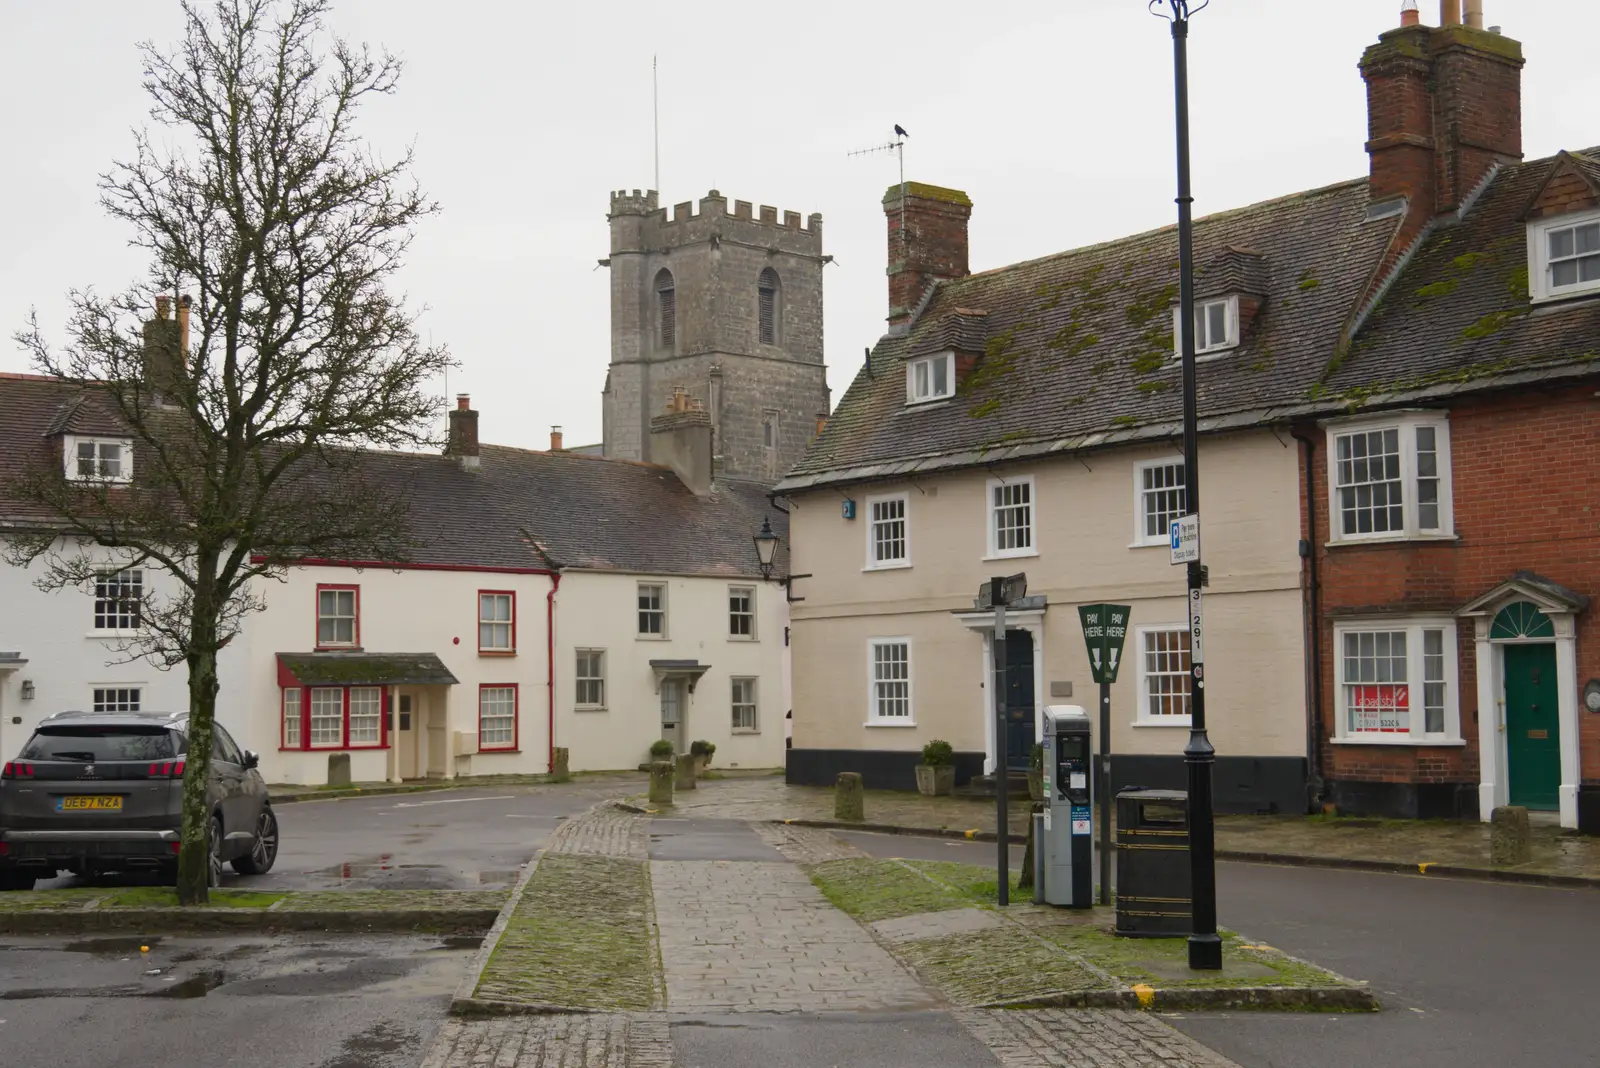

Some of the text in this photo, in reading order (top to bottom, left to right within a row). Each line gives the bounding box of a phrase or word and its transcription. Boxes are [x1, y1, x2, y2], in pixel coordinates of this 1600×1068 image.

[1173, 525, 1179, 547] P
[1193, 590, 1200, 600] 3
[1086, 613, 1098, 624] PAY
[1111, 613, 1123, 624] PAY
[1085, 626, 1103, 638] HERE
[1106, 626, 1125, 638] HERE
[97, 797, 120, 808] NZA
